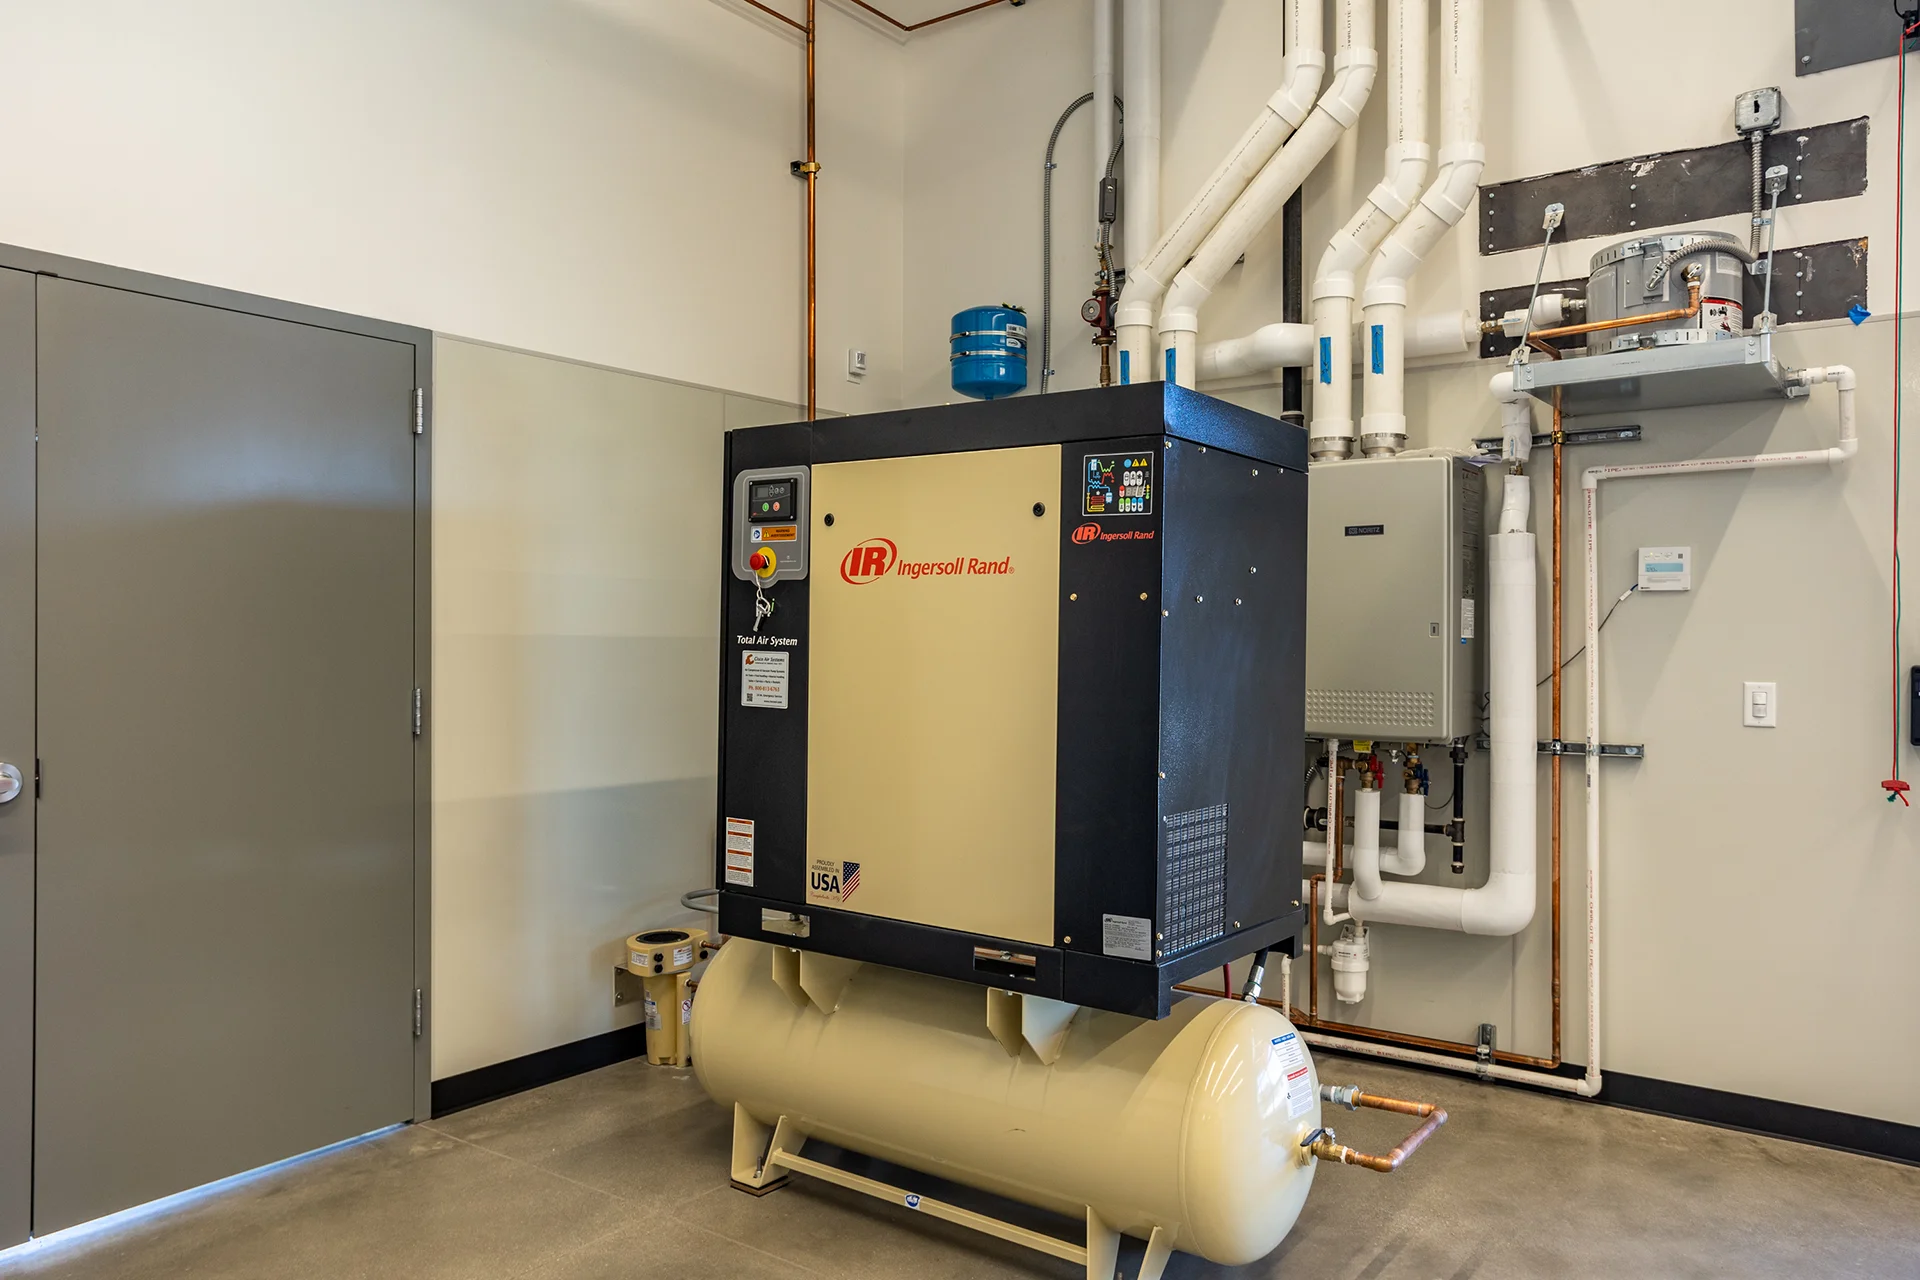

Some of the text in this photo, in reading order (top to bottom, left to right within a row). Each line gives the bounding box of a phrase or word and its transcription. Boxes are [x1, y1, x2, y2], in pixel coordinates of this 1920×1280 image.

[1100, 530, 1155, 542] Ingersoll Rand
[897, 557, 965, 579] Ingersoll
[736, 635, 798, 647] Total Air System
[811, 872, 840, 894] USA
